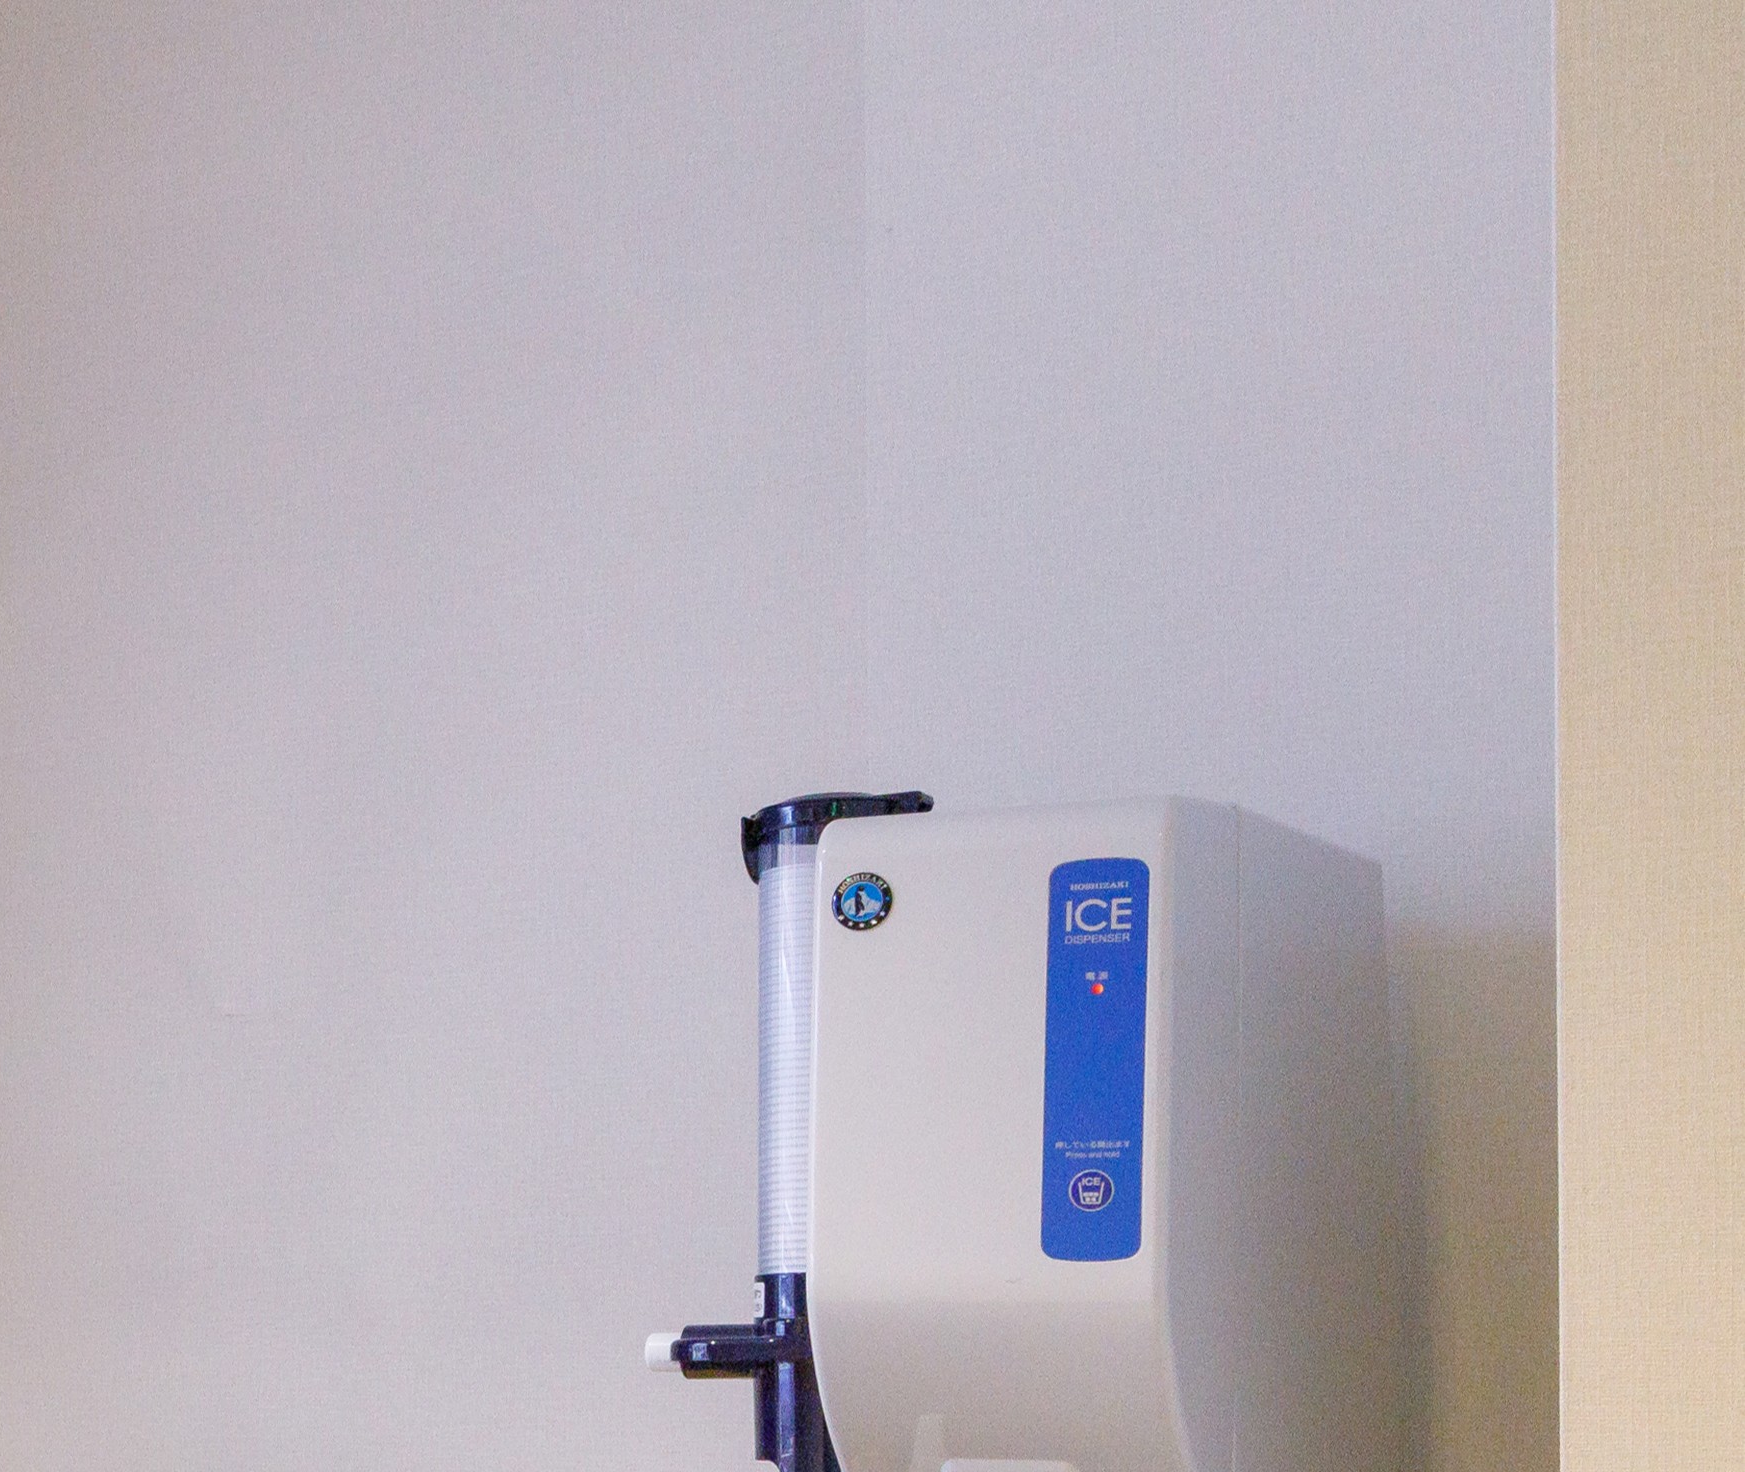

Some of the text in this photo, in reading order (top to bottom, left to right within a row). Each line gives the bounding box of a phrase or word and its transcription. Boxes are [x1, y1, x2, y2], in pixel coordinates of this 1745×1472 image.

[1070, 881, 1129, 891] HOSHIZAKI
[1065, 898, 1132, 932] ICE
[1064, 932, 1130, 944] DISPENSER
[1081, 1177, 1101, 1186] ICE
